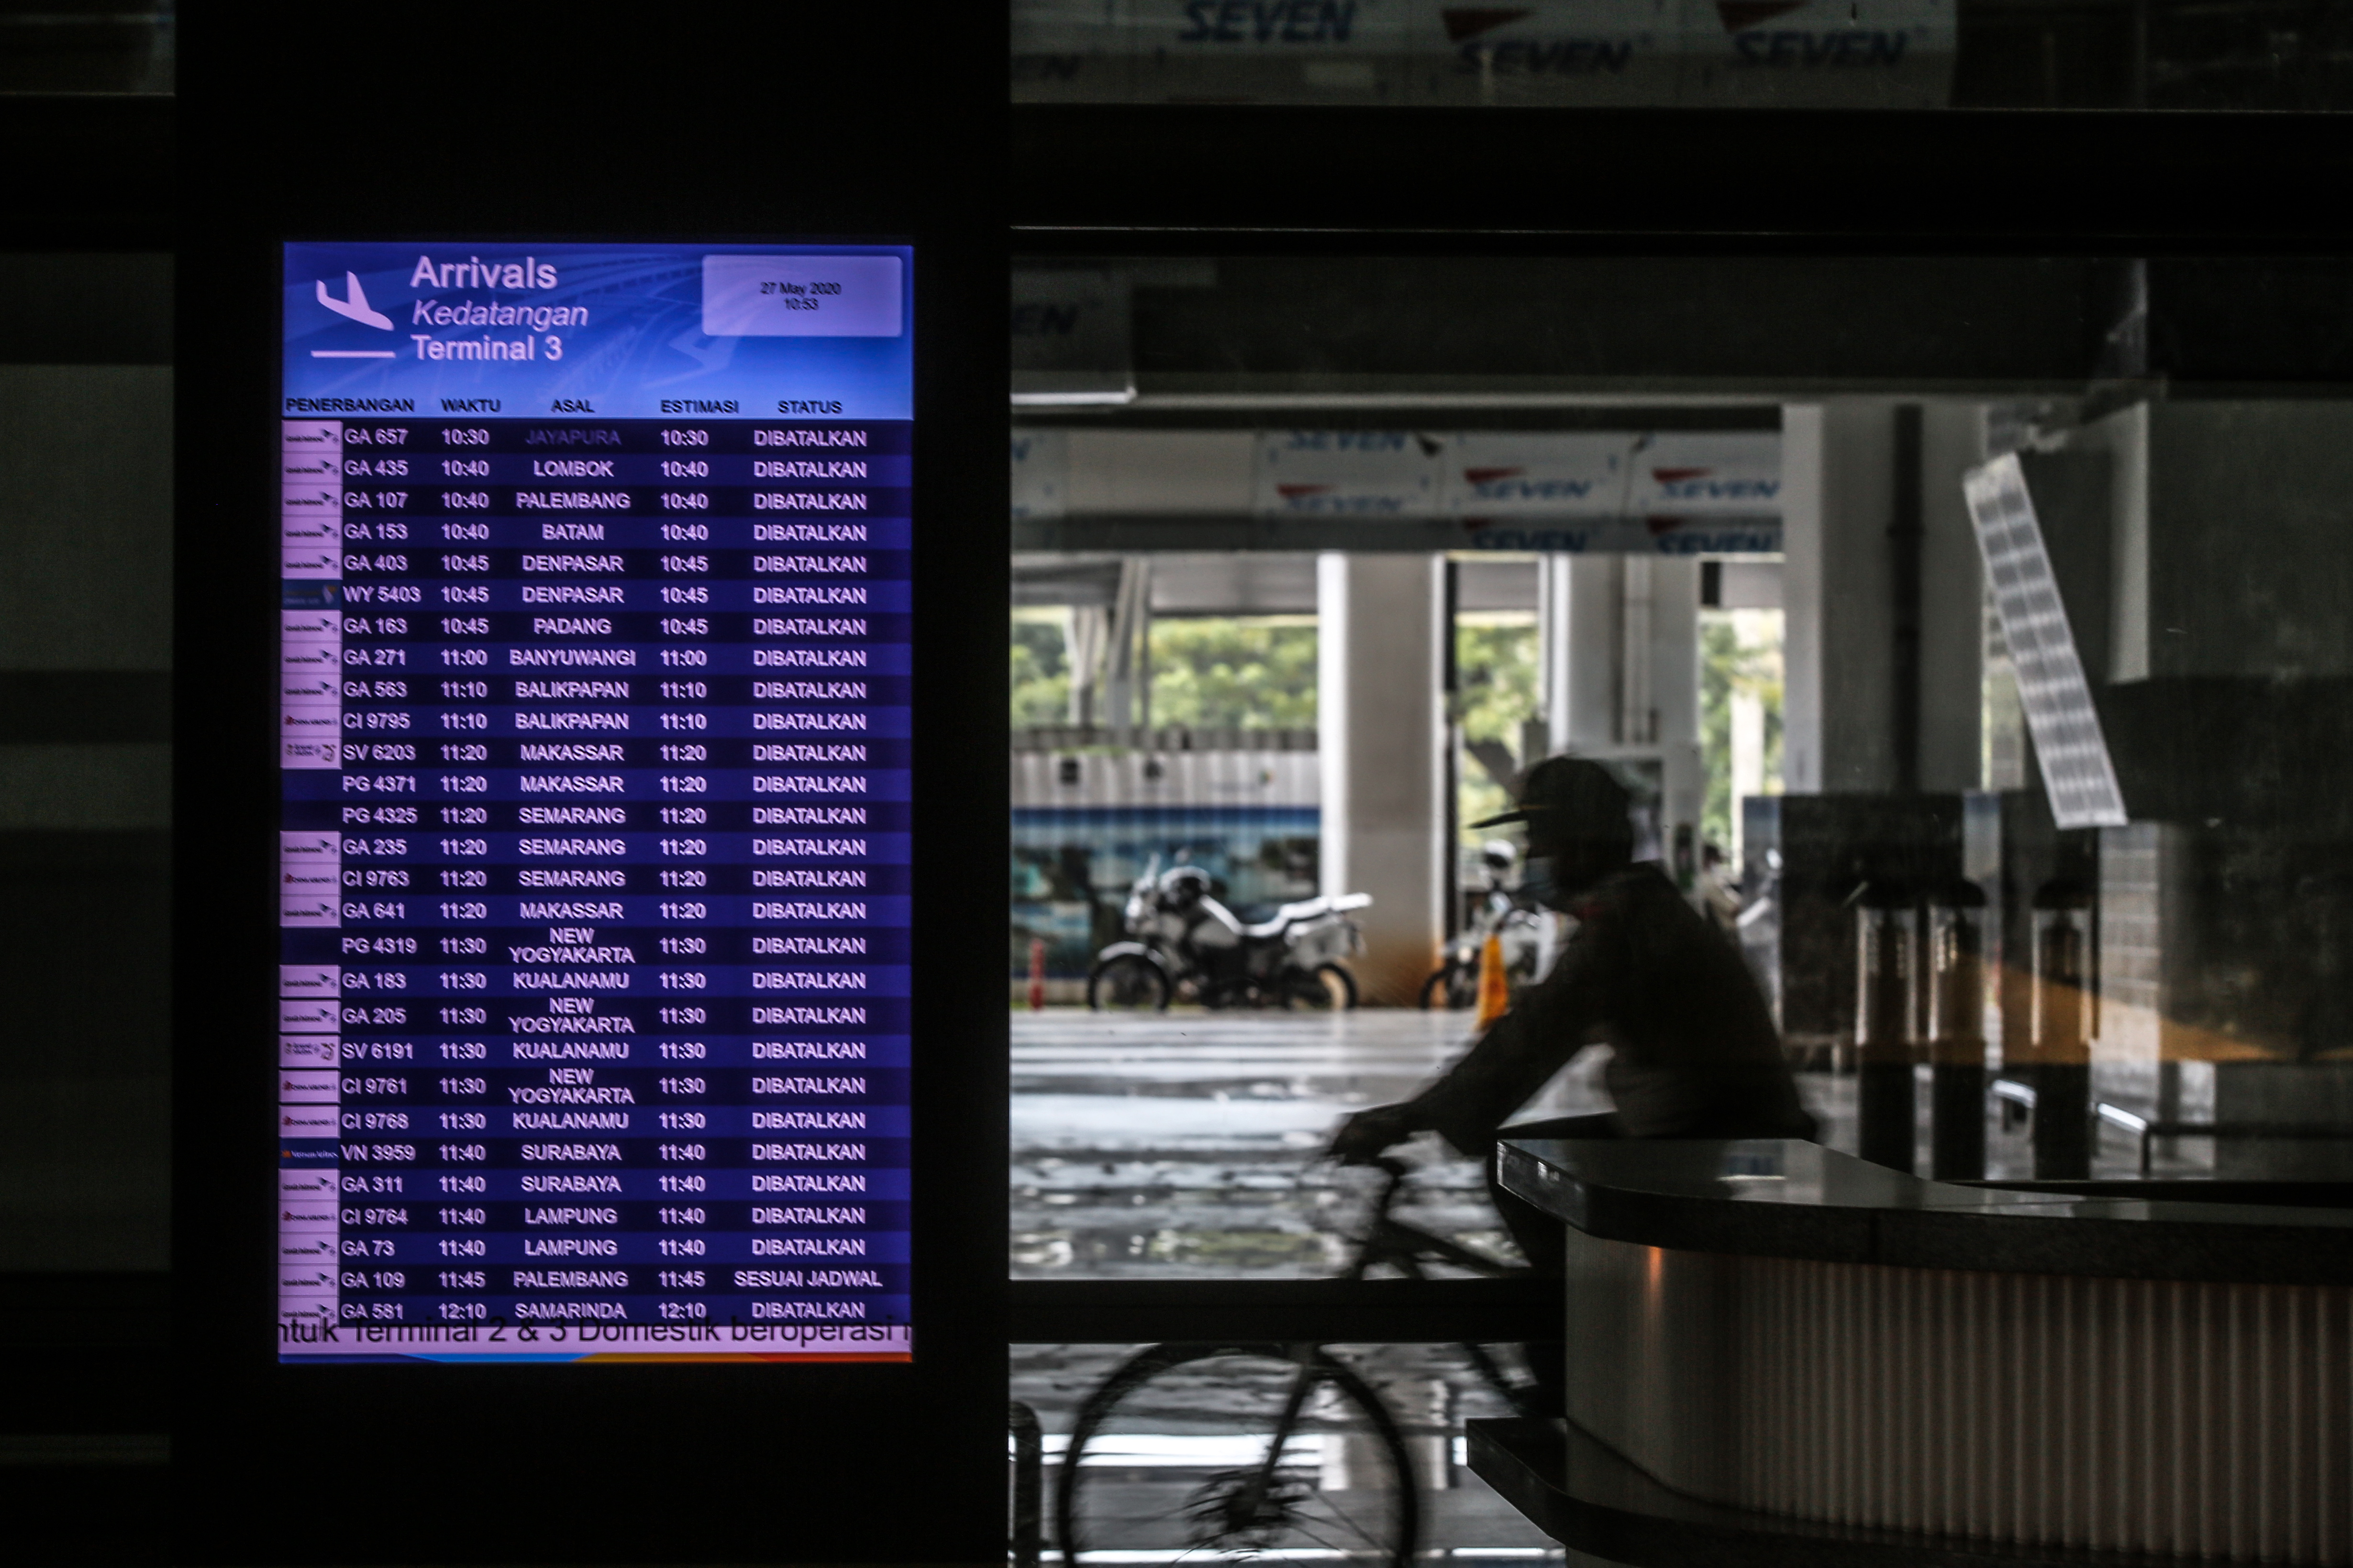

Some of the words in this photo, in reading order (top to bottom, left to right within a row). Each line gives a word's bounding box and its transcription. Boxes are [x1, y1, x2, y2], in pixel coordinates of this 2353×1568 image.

[1179, 0, 1355, 42] SEVEN
[1726, 29, 1906, 68] SEVEN
[410, 255, 558, 289] Arrivals
[760, 282, 777, 295] 27
[779, 282, 807, 297] May
[810, 282, 842, 295] 2020
[785, 298, 819, 310] 10:53
[412, 299, 589, 332] Kedatangan
[411, 334, 535, 360] Terminal
[544, 335, 563, 361] 3
[287, 398, 415, 412] PENERBANGAN
[441, 398, 501, 412] WAKTU
[551, 399, 595, 414] ASAL
[661, 399, 739, 414] ESTIMASI
[777, 399, 843, 414] STATUS
[344, 428, 373, 445] GA
[375, 428, 409, 445] 657
[442, 429, 489, 445] 10:30
[525, 429, 622, 445] JAYAPURA
[661, 430, 709, 446] 10:30
[754, 430, 866, 447] DIBATALKAN
[344, 460, 372, 476] GA
[375, 460, 409, 476] 435
[442, 460, 489, 476] 10:40
[533, 460, 614, 477] LOMBOK
[661, 461, 709, 477] 10:40
[754, 461, 866, 478] DIBATALKAN
[344, 523, 372, 540] GA
[376, 523, 408, 540] 153
[441, 523, 489, 540] 10:40
[542, 524, 604, 541] BATAM
[660, 524, 709, 541] 10:40
[754, 524, 866, 541] DIBATALKAN
[344, 554, 372, 571] GA
[374, 554, 408, 571] 403
[442, 555, 489, 571] 10:45
[522, 555, 624, 572] DENPASAR
[661, 555, 709, 572] 10:45
[754, 556, 866, 573] DIBATALKAN
[344, 618, 372, 634] GA
[376, 618, 408, 634] 163
[441, 618, 489, 634] 10:45
[534, 618, 611, 634] PADANG
[660, 618, 708, 635] 10:45
[754, 618, 866, 635] DIBATALKAN
[344, 649, 372, 665] GA
[374, 649, 405, 665] 271
[441, 649, 488, 666] 11:00
[510, 649, 636, 666] BANYUWANGI
[660, 650, 707, 666] 11:00
[754, 650, 866, 667] DIBATALKAN
[344, 713, 363, 729] CI
[366, 713, 411, 729] 9795
[441, 713, 488, 729] 11:10
[515, 713, 629, 729] BALIKPAPAN
[660, 713, 707, 730] 11:10
[753, 713, 866, 730] DIBATALKAN
[343, 744, 369, 761] SV
[372, 744, 416, 761] 6203
[441, 744, 487, 761] 11:20
[521, 744, 624, 761] MAKASSAR
[660, 744, 707, 761] 11:20
[753, 745, 866, 761] DIBATALKAN
[343, 807, 370, 824] PG
[373, 807, 418, 824] 4325
[440, 807, 487, 824] 11:20
[519, 807, 626, 824] SEMARANG
[660, 807, 707, 824] 11:20
[753, 807, 866, 824] DIBATALKAN
[343, 839, 371, 855] GA
[373, 839, 407, 855] 235
[440, 839, 487, 855] 11:20
[519, 839, 626, 855] SEMARANG
[660, 839, 707, 855] 11:20
[753, 839, 866, 855] DIBATALKAN
[343, 902, 371, 919] GA
[373, 902, 405, 919] 641
[440, 902, 487, 919] 11:20
[520, 902, 624, 919] MAKASSAR
[659, 902, 707, 919] 11:20
[753, 902, 866, 919] DIBATALKAN
[550, 928, 595, 944] NEW
[342, 938, 370, 954] PG
[373, 938, 417, 954] 4319
[440, 938, 487, 954] 11:30
[659, 938, 706, 954] 11:30
[753, 937, 866, 954] DIBATALKAN
[509, 947, 635, 963] YOGYAKARTA
[342, 972, 370, 989] GA
[374, 972, 407, 989] 183
[440, 972, 487, 989] 11:30
[513, 972, 629, 989] KUALANAMU
[659, 972, 706, 989] 11:30
[753, 972, 866, 989] DIBATALKAN
[342, 1043, 368, 1059] SV
[371, 1043, 413, 1059] 6191
[439, 1042, 487, 1059] 11:30
[513, 1042, 629, 1059] KUALANAMU
[659, 1042, 706, 1059] 11:30
[753, 1042, 866, 1059] DIBATALKAN
[549, 1068, 594, 1085] NEW
[342, 1078, 361, 1094] CI
[365, 1078, 407, 1094] 9761
[439, 1078, 486, 1094] 11:30
[659, 1077, 706, 1094] 11:30
[752, 1077, 866, 1094] DIBATALKAN
[508, 1087, 635, 1104] YOGYAKARTA
[341, 1144, 367, 1161] VN
[372, 1144, 416, 1161] 3959
[439, 1144, 486, 1161] 11:40
[522, 1144, 622, 1160] SURABAYA
[659, 1144, 706, 1160] 11:40
[752, 1144, 866, 1160] DIBATALKAN
[341, 1176, 370, 1193] GA
[372, 1176, 402, 1193] 311
[439, 1176, 486, 1193] 11:40
[521, 1175, 622, 1192] SURABAYA
[659, 1175, 706, 1192] 11:40
[752, 1175, 866, 1192] DIBATALKAN
[341, 1240, 369, 1256] GA
[372, 1240, 395, 1256] 73
[439, 1239, 486, 1256] 11:40
[524, 1239, 618, 1256] LAMPUNG
[341, 1271, 369, 1288] GA
[373, 1271, 405, 1288] 109
[439, 1271, 486, 1288] 11:45
[514, 1271, 628, 1288] PALEMBANG
[658, 1270, 705, 1287] 11:45
[734, 1270, 803, 1287] SESUAI
[807, 1270, 883, 1287] JADWAL
[341, 1303, 368, 1320] GA
[372, 1303, 403, 1320] 581
[438, 1303, 487, 1319] 12:10
[515, 1303, 627, 1319] SAMARINDA
[658, 1302, 707, 1319] 12:10
[752, 1302, 865, 1318] DIBATALKAN
[353, 1316, 477, 1342] Terminal
[488, 1316, 506, 1341] 2
[517, 1316, 540, 1342] &
[549, 1316, 567, 1342] 3
[579, 1316, 720, 1342] Domestik
[732, 1315, 893, 1347] beroperasi
